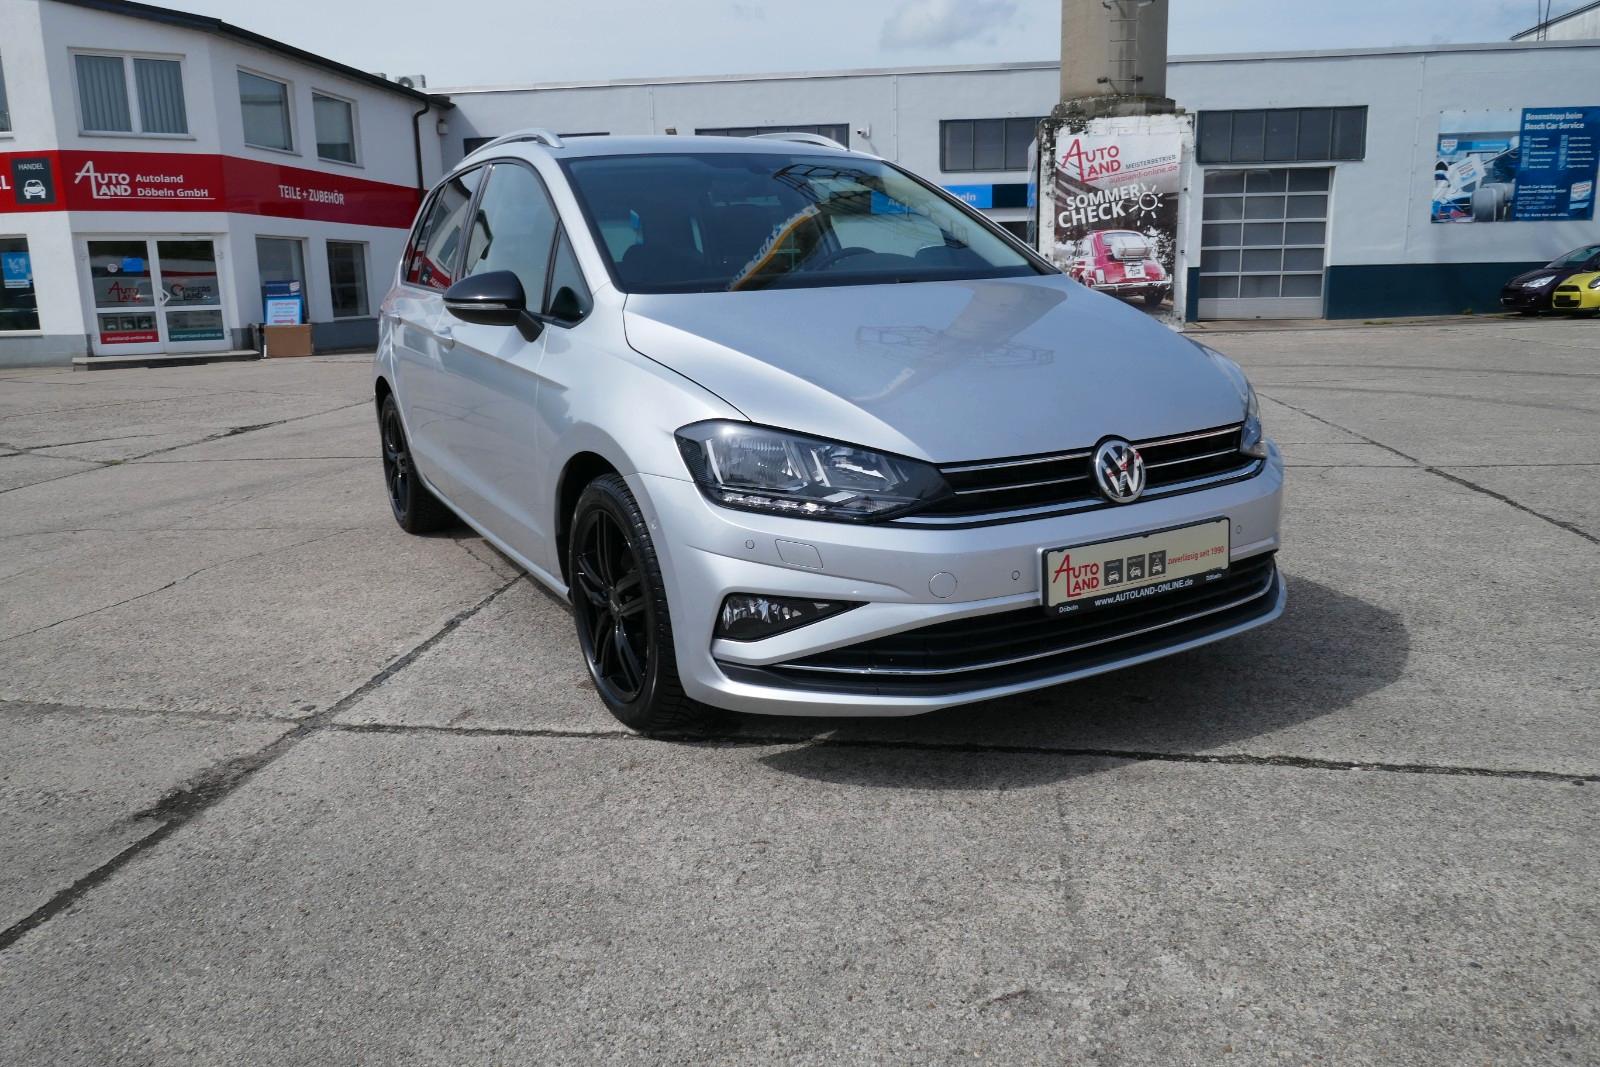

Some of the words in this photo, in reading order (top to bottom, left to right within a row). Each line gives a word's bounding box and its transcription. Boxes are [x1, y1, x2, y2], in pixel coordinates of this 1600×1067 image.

[1062, 138, 1120, 169] AUTO
[0, 175, 11, 190] L
[75, 161, 130, 185] AUTO
[135, 174, 184, 183] Autoland
[1080, 159, 1121, 183] LAND
[92, 184, 132, 199] LAND
[137, 187, 175, 197] Döbeln
[176, 188, 209, 197] GmbH
[278, 184, 301, 200] TEILE
[308, 189, 345, 206] ZUBEHÖR
[1066, 183, 1141, 211] SOMMER
[1058, 200, 1126, 228] CHECK
[1200, 550, 1210, 558] seit
[1211, 545, 1225, 555] 1990
[1053, 554, 1099, 583] AUTO
[1067, 577, 1099, 597] LAND
[1094, 578, 1193, 606] www.AUTOLAND-ONLINE.de
